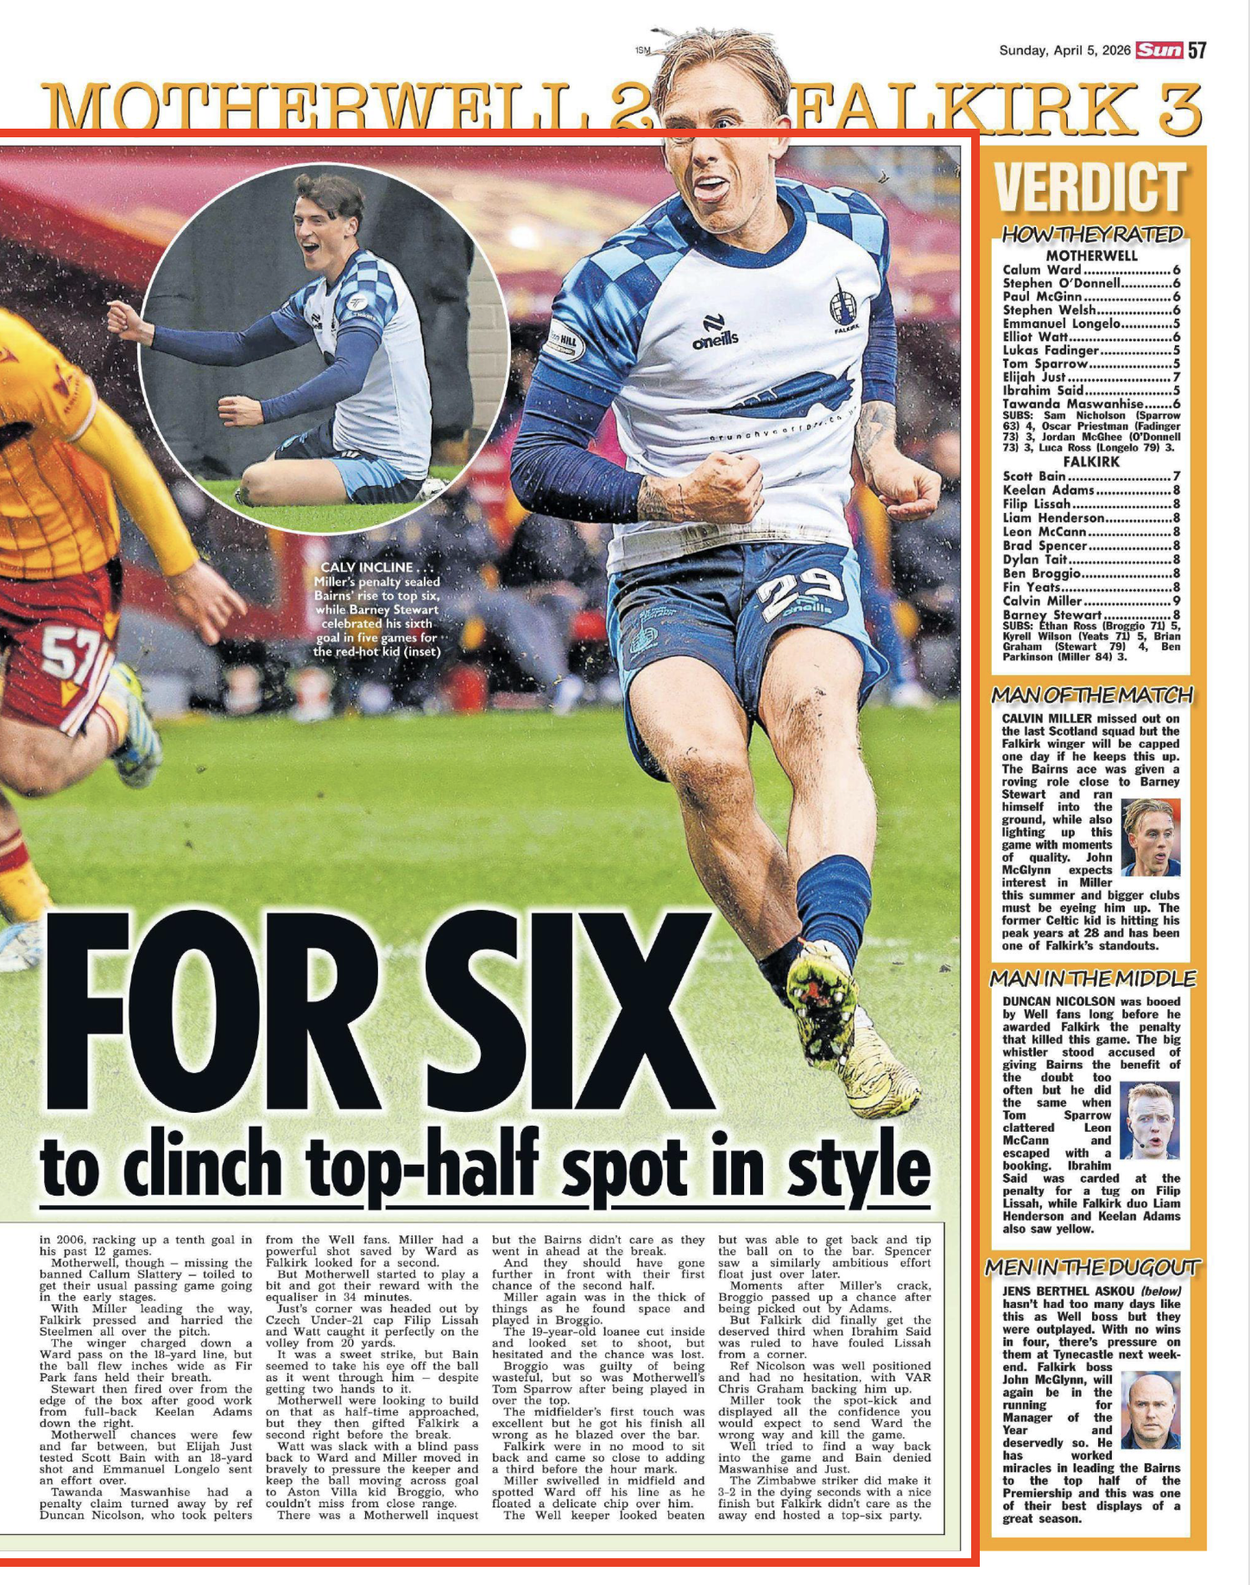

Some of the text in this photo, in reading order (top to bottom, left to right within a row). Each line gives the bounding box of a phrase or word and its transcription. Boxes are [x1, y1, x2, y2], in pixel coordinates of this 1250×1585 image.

[999, 41, 1207, 60] Sunday, April 5, 2026 Sun 57
[41, 81, 655, 130] MOTHERWELL 2
[794, 82, 1204, 138] FALKIRK 3
[994, 161, 1187, 212] VERDICT
[1003, 225, 1184, 243] HOW THEY RATED
[1046, 249, 1139, 262] MOTHERWELL
[1002, 410, 1182, 423] SUBS: Sam Nicholson (Sparrow
[1063, 455, 1121, 468] FALKIRK
[320, 561, 356, 573] CALV
[359, 561, 414, 573] INCLINE
[358, 576, 402, 590] penalty
[404, 576, 441, 588] sealed
[357, 591, 379, 602] rise
[381, 591, 395, 602] to
[397, 591, 418, 604] top
[421, 591, 440, 603] six,
[755, 567, 845, 624] 29
[41, 624, 101, 686] 57
[992, 686, 1194, 704] MAN OF THE MATCH
[990, 970, 1197, 988] MAN IN THE MIDDLE
[46, 909, 383, 1114] FOR
[425, 908, 717, 1114] SIX
[39, 1138, 100, 1197] to
[122, 1125, 283, 1197] clinch
[305, 1125, 539, 1211] top-half
[561, 1138, 688, 1211] spot
[712, 1130, 764, 1196] in
[787, 1125, 931, 1211] style
[985, 1258, 1202, 1278] MEN IN THE DUGOUT
[718, 1509, 922, 1522] away end hosted a top-six party.
[1002, 1513, 1083, 1526] great season.
